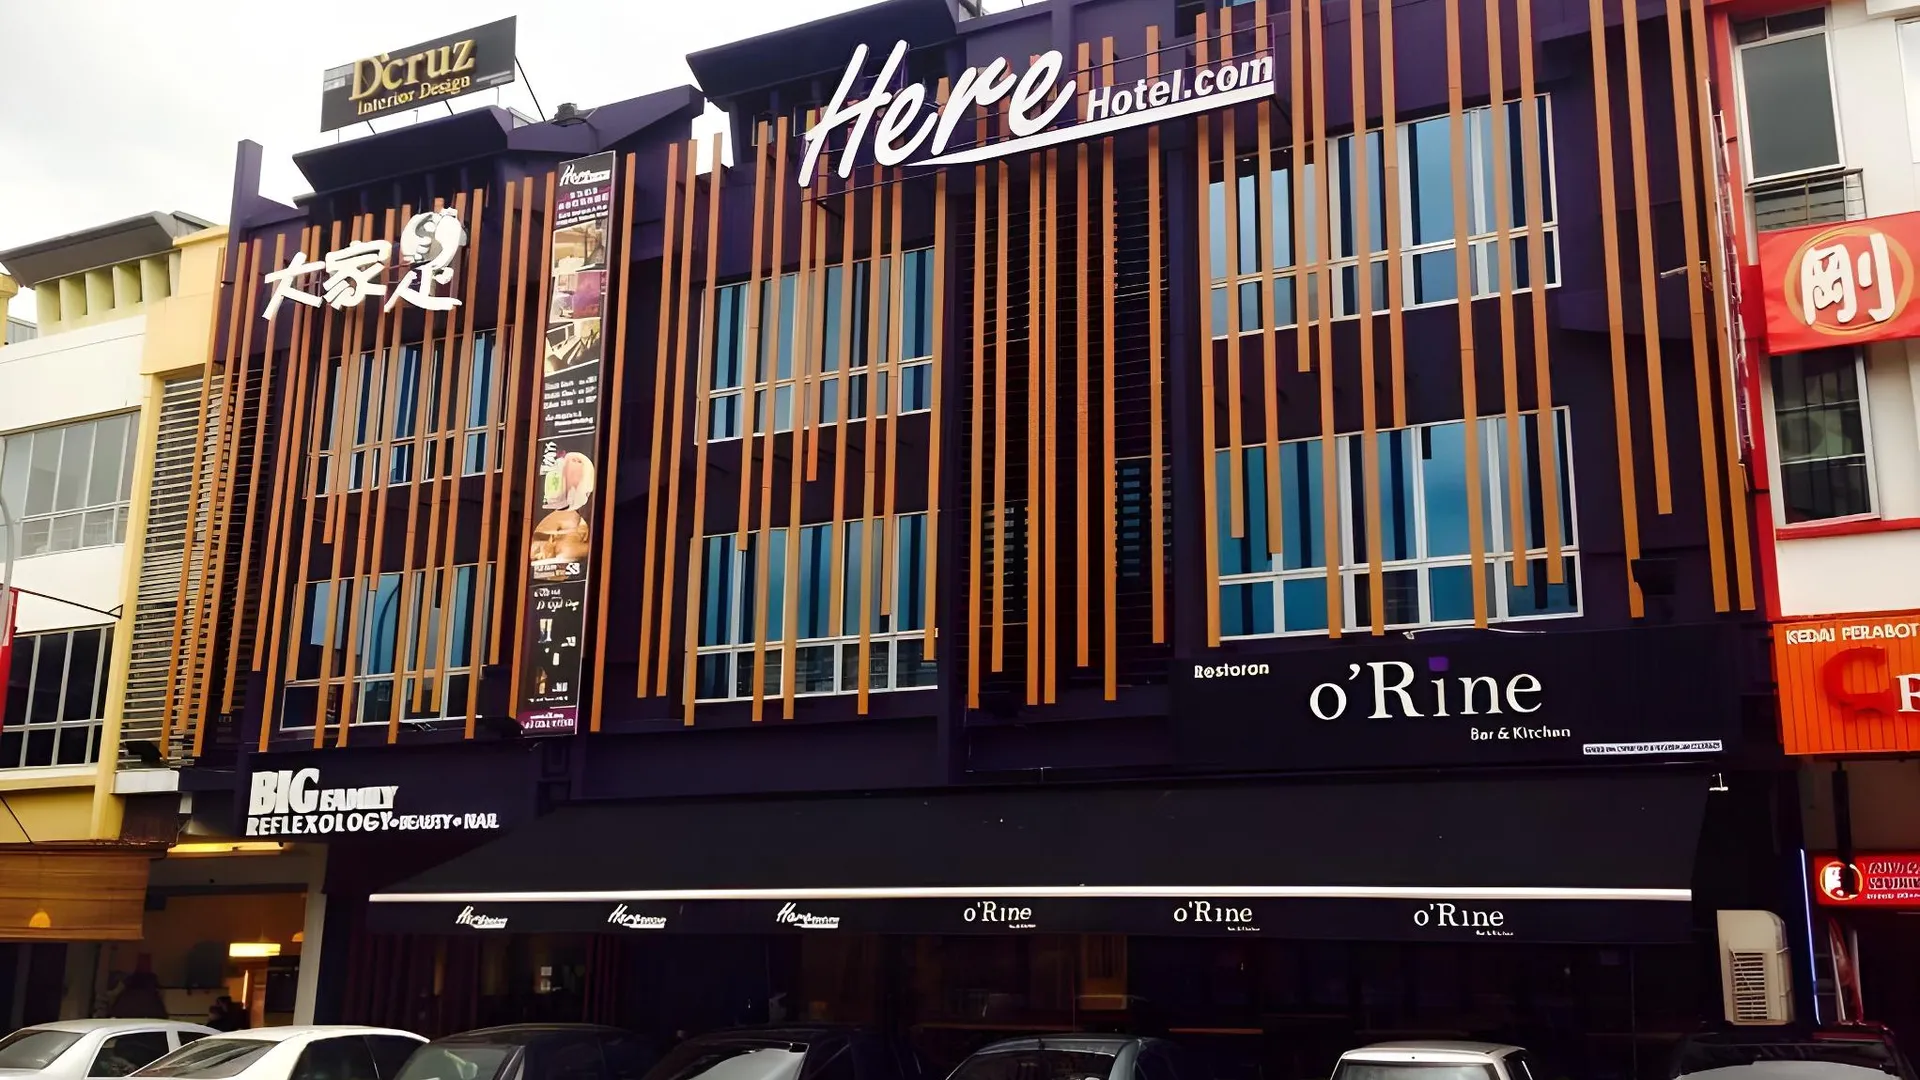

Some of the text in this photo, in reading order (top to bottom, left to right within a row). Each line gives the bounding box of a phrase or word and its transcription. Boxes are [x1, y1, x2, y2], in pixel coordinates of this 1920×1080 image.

[358, 75, 471, 116] Interior Design
[1086, 56, 1273, 122] Hotel.com
[798, 39, 1077, 188] Here
[1309, 657, 1543, 721] o'Rine
[1497, 727, 1510, 740] &
[248, 767, 320, 816] BIG
[1173, 900, 1253, 922] o'Rine
[1413, 902, 1504, 927] o'Rine
